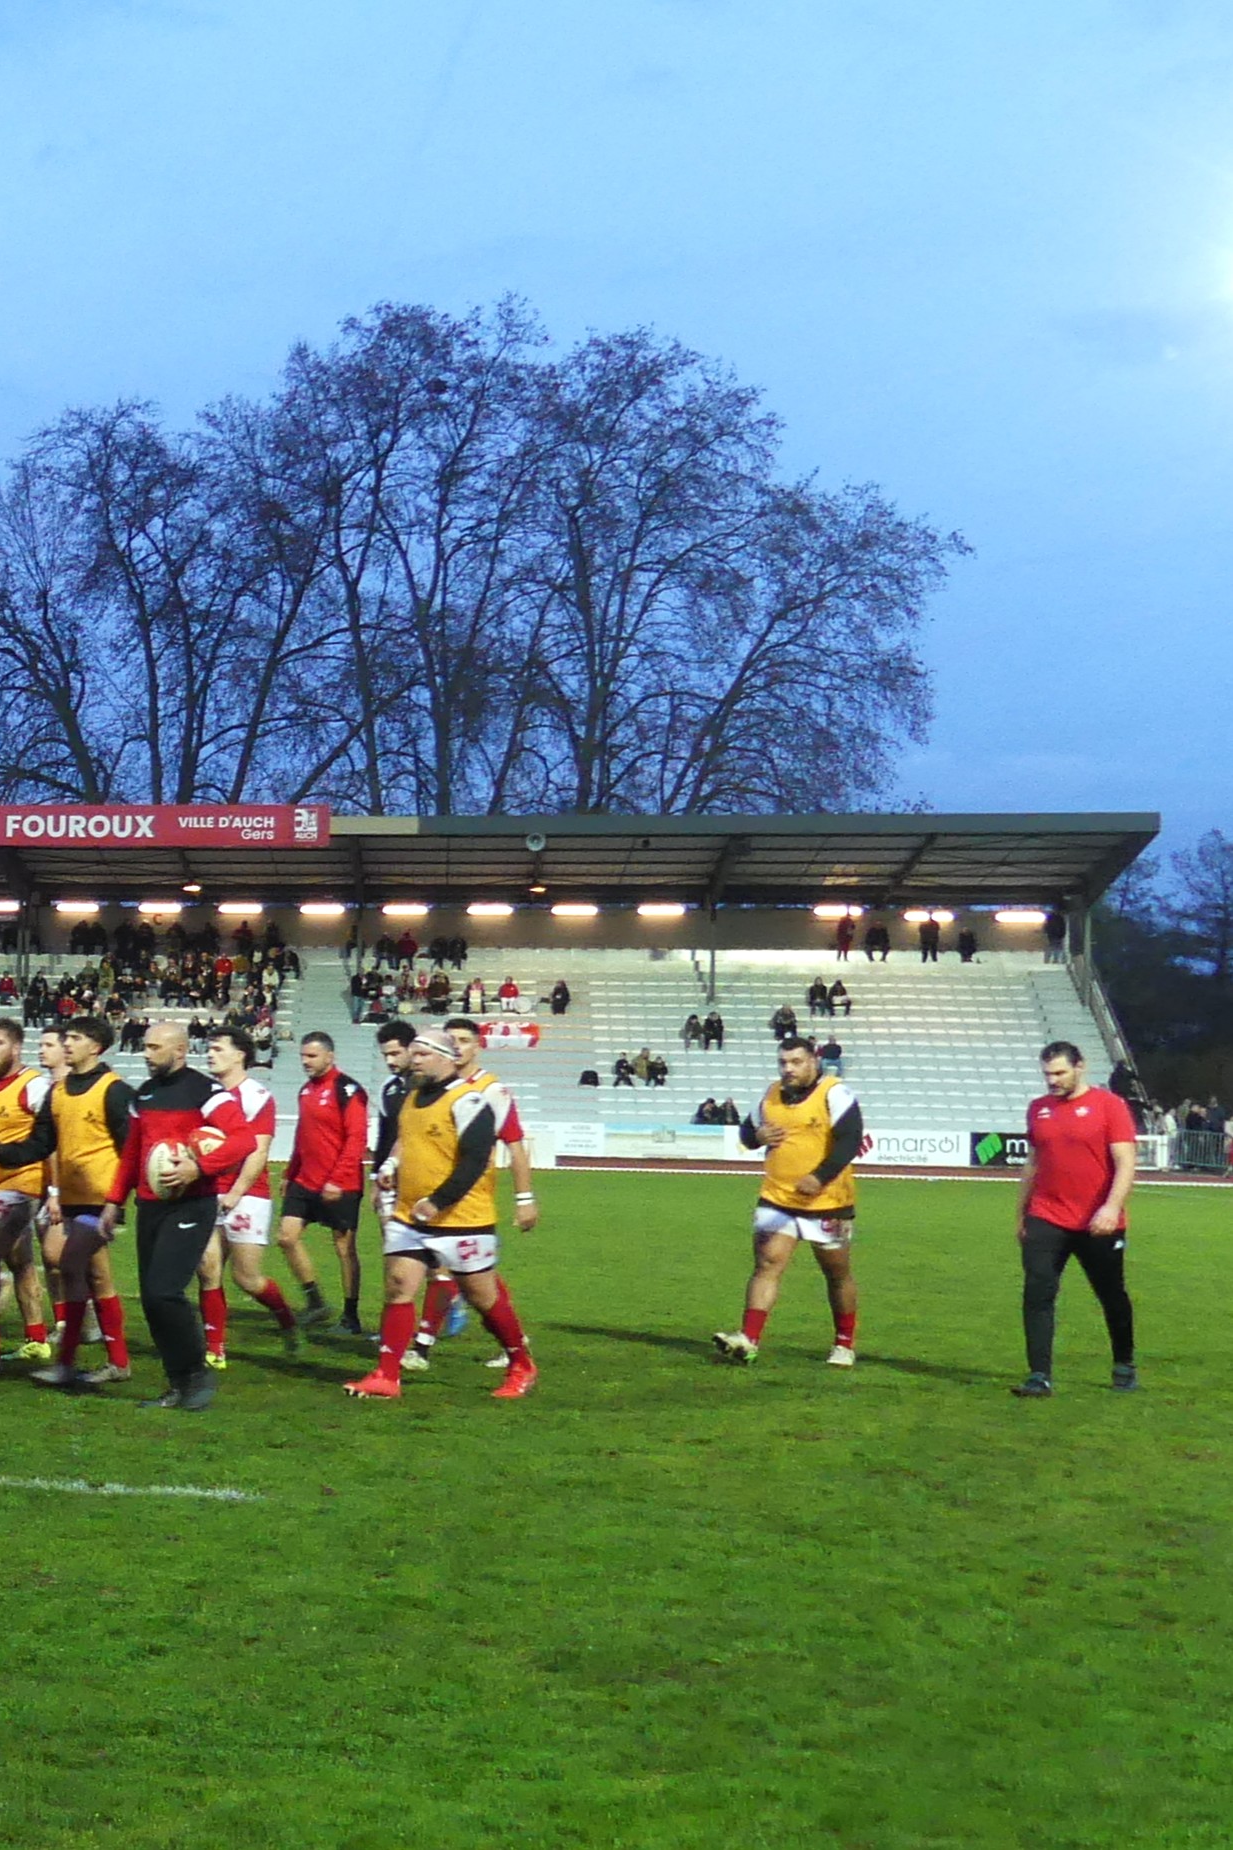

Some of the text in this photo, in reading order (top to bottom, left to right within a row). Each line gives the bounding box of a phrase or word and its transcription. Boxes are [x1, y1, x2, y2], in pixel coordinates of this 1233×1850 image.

[6, 815, 155, 838] FOUROUX
[178, 815, 275, 828] VILLE D'AUCH
[241, 829, 274, 840] Gers
[294, 832, 317, 840] AUCH
[877, 1135, 960, 1153] marsol
[877, 1154, 929, 1164] électricité
